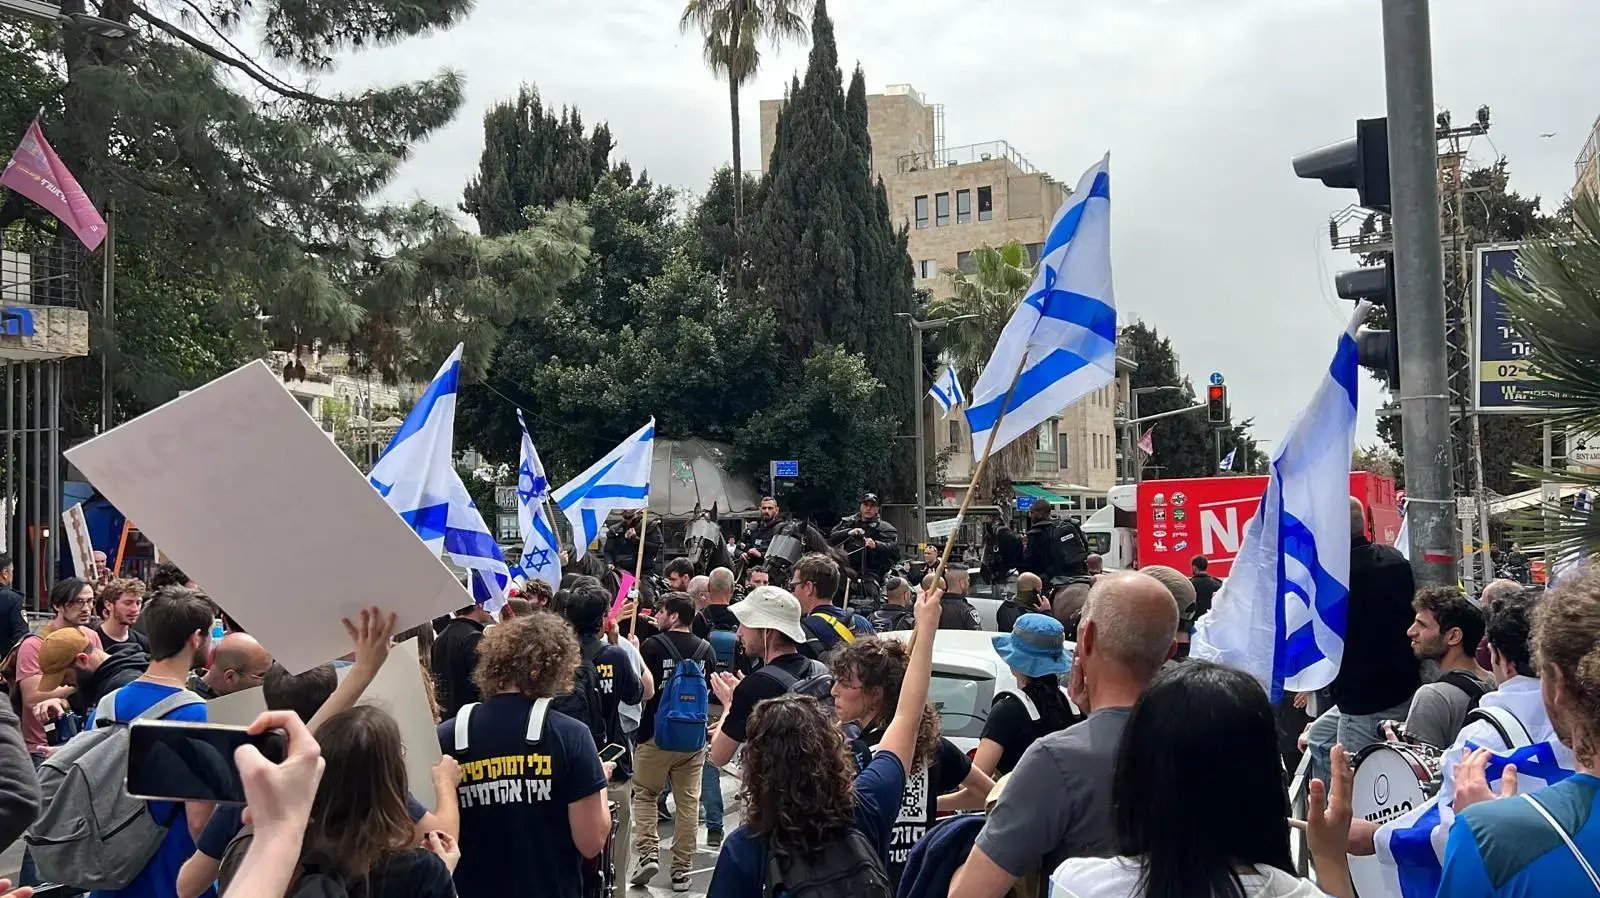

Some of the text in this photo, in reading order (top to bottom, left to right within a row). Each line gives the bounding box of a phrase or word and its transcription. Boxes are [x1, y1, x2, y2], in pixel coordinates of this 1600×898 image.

[527, 753, 552, 776] בלי
[459, 779, 552, 808] אין אקדמיה
